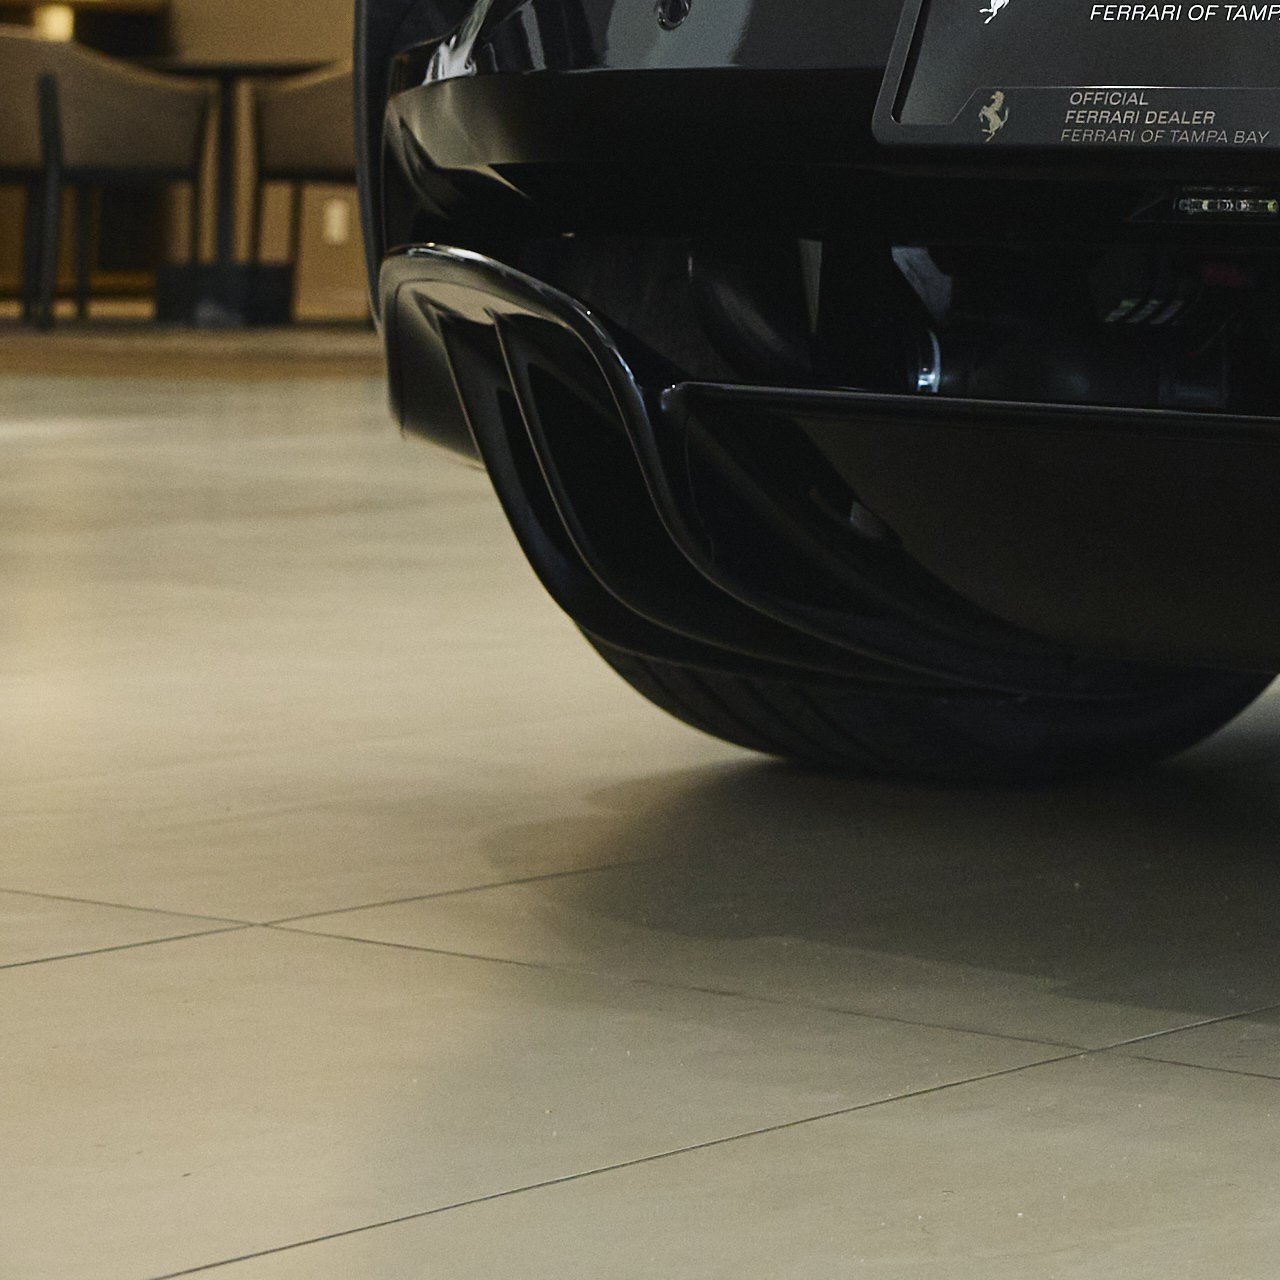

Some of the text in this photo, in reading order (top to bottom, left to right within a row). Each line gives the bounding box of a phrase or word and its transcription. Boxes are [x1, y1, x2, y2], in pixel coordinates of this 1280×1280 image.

[1090, 4, 1182, 21] FERRARI
[1187, 4, 1220, 21] OF
[1069, 91, 1149, 106] OFFICIAL
[1064, 110, 1216, 125] FERRARI DEALER
[1060, 128, 1270, 144] FERRARI OF TAMPA BAY
